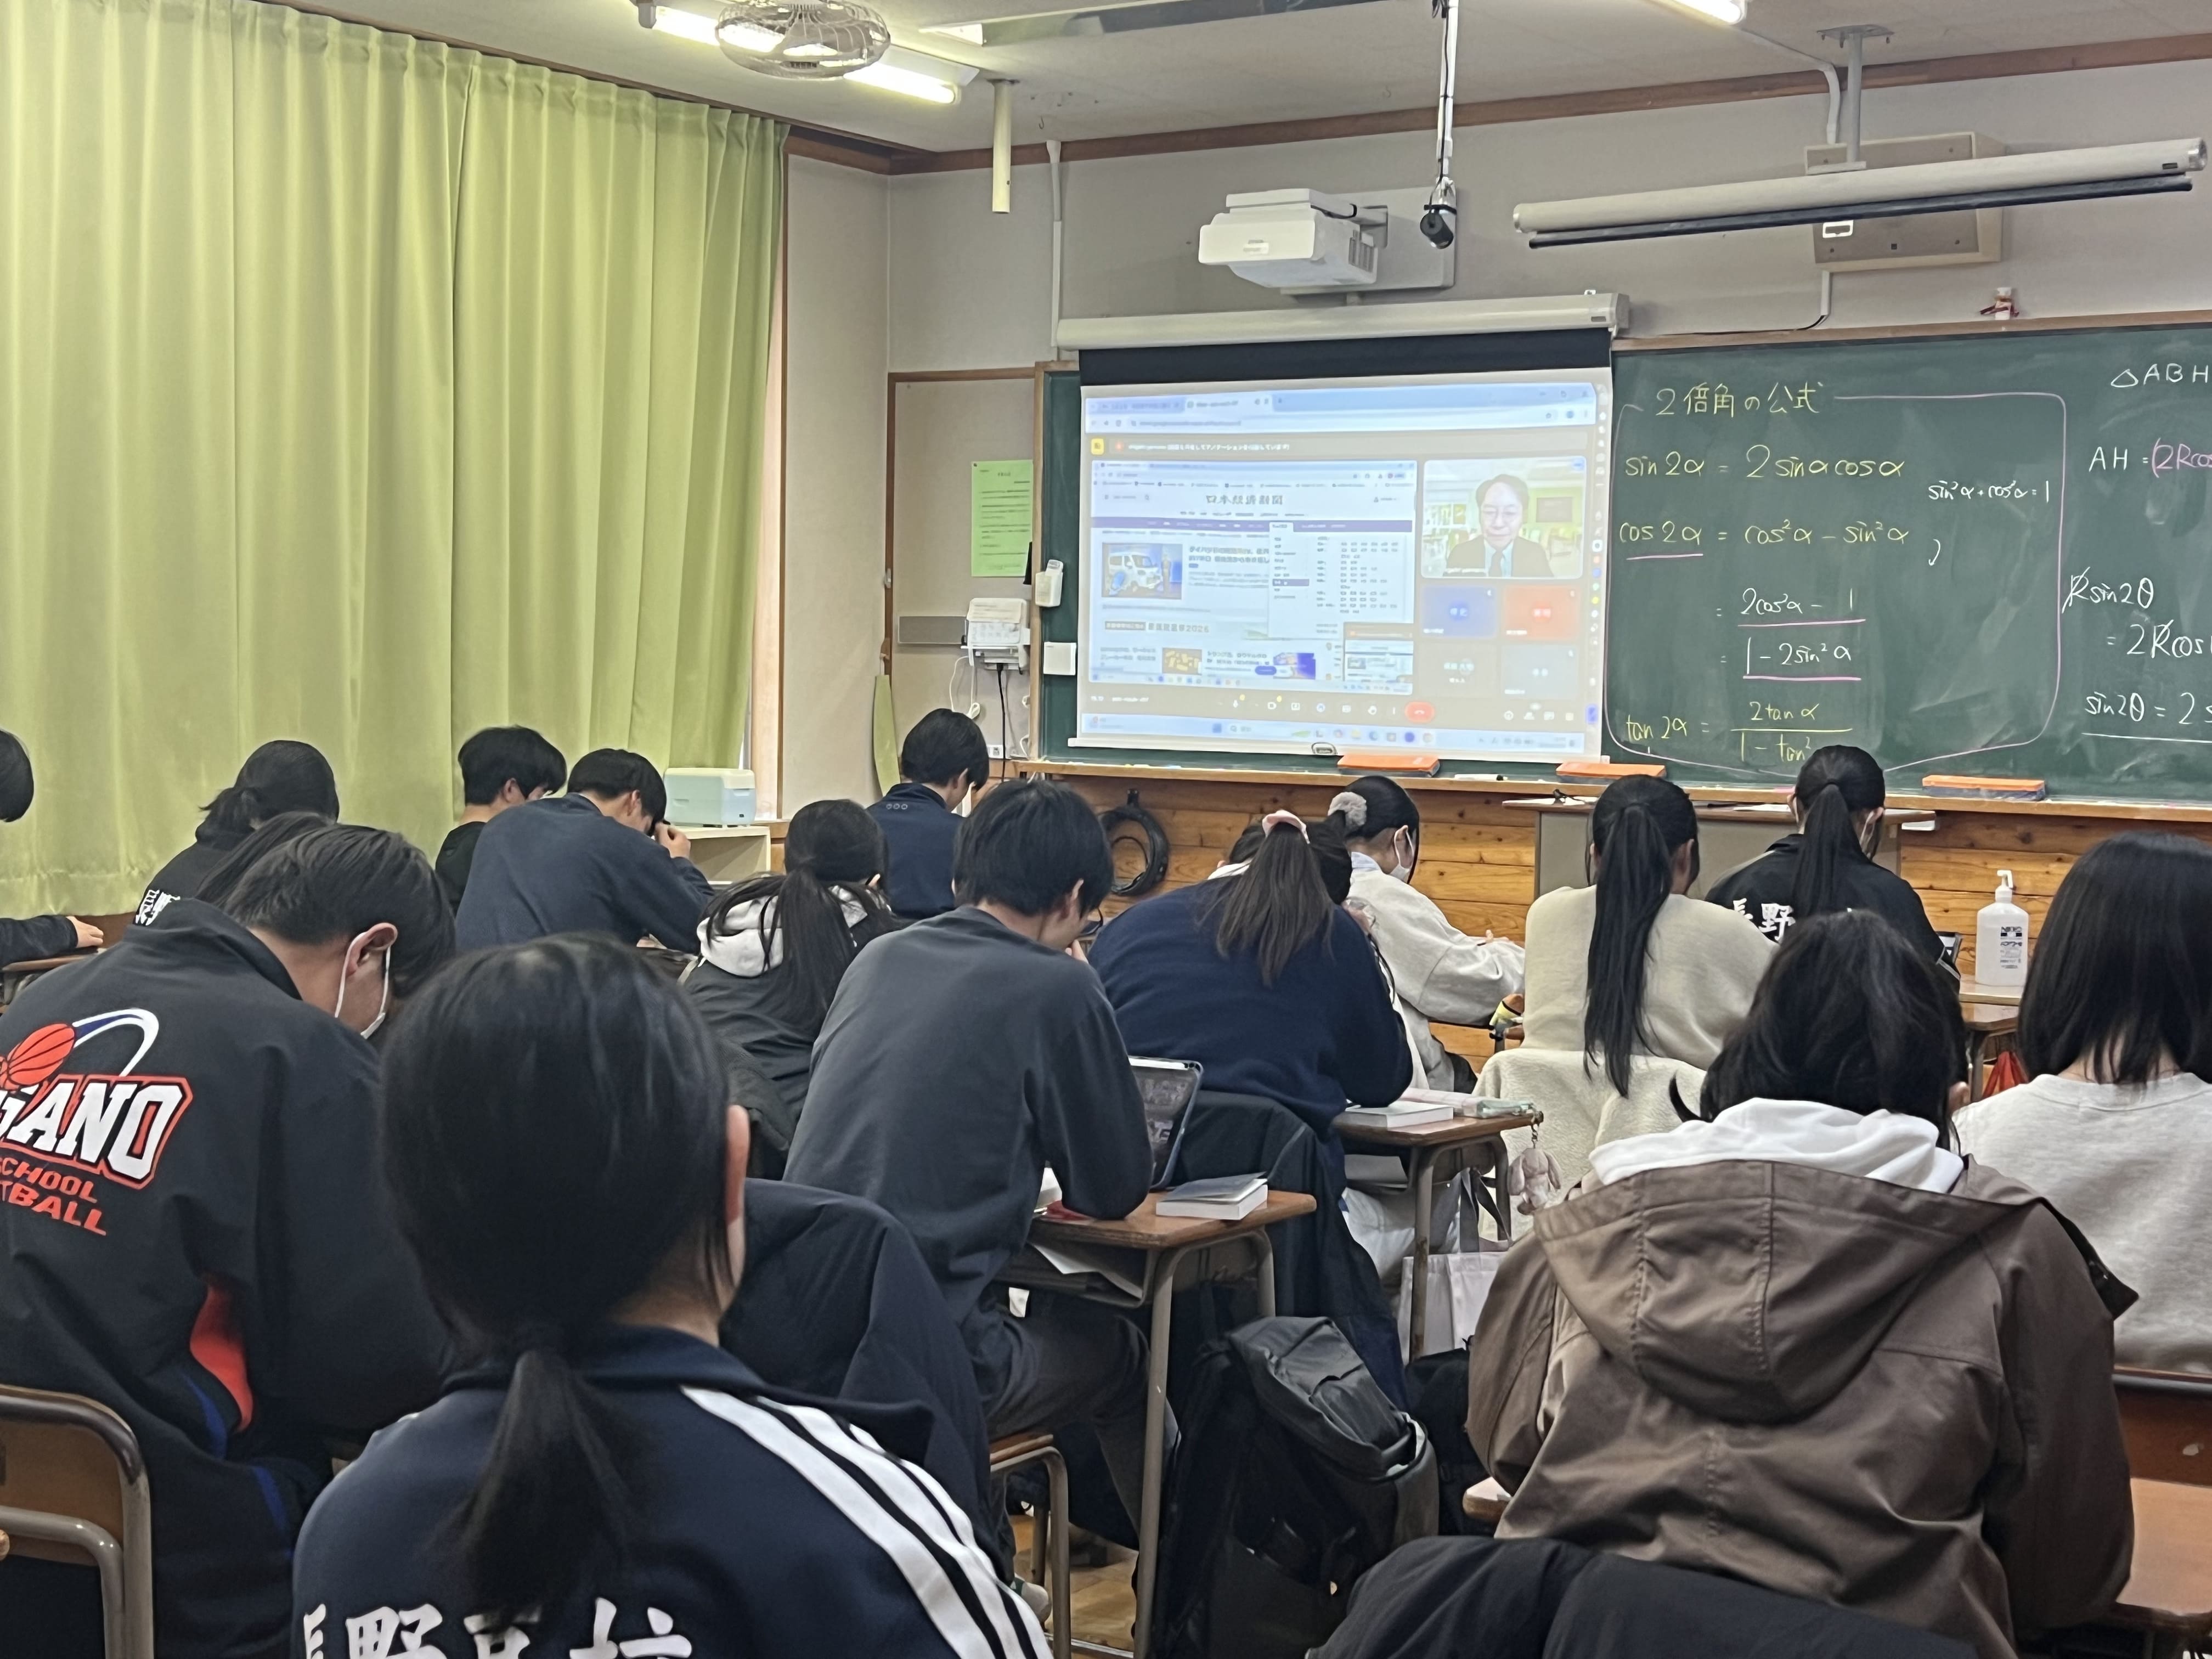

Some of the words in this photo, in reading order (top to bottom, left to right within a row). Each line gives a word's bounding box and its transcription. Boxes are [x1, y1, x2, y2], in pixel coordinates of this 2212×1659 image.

[1656, 381, 1824, 417] 2倍角の公式
[0, 1157, 98, 1204] CHOOL
